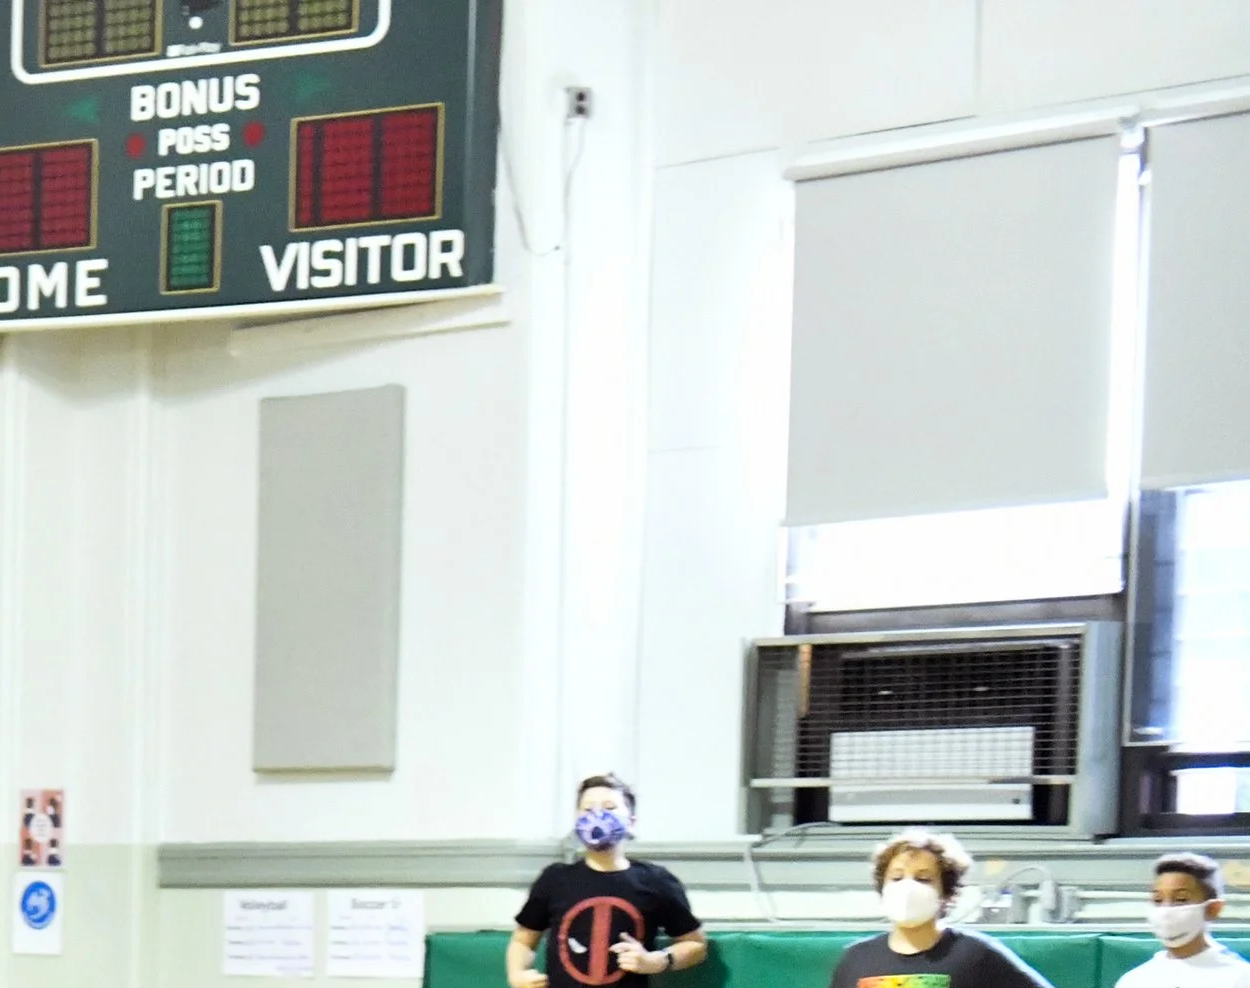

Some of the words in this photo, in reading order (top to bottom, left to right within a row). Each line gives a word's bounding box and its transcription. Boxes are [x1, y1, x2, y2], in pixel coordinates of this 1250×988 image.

[130, 73, 261, 122] BONUS
[158, 123, 230, 156] POSS
[133, 159, 255, 201] PERIOD
[259, 229, 465, 292] VISITOR
